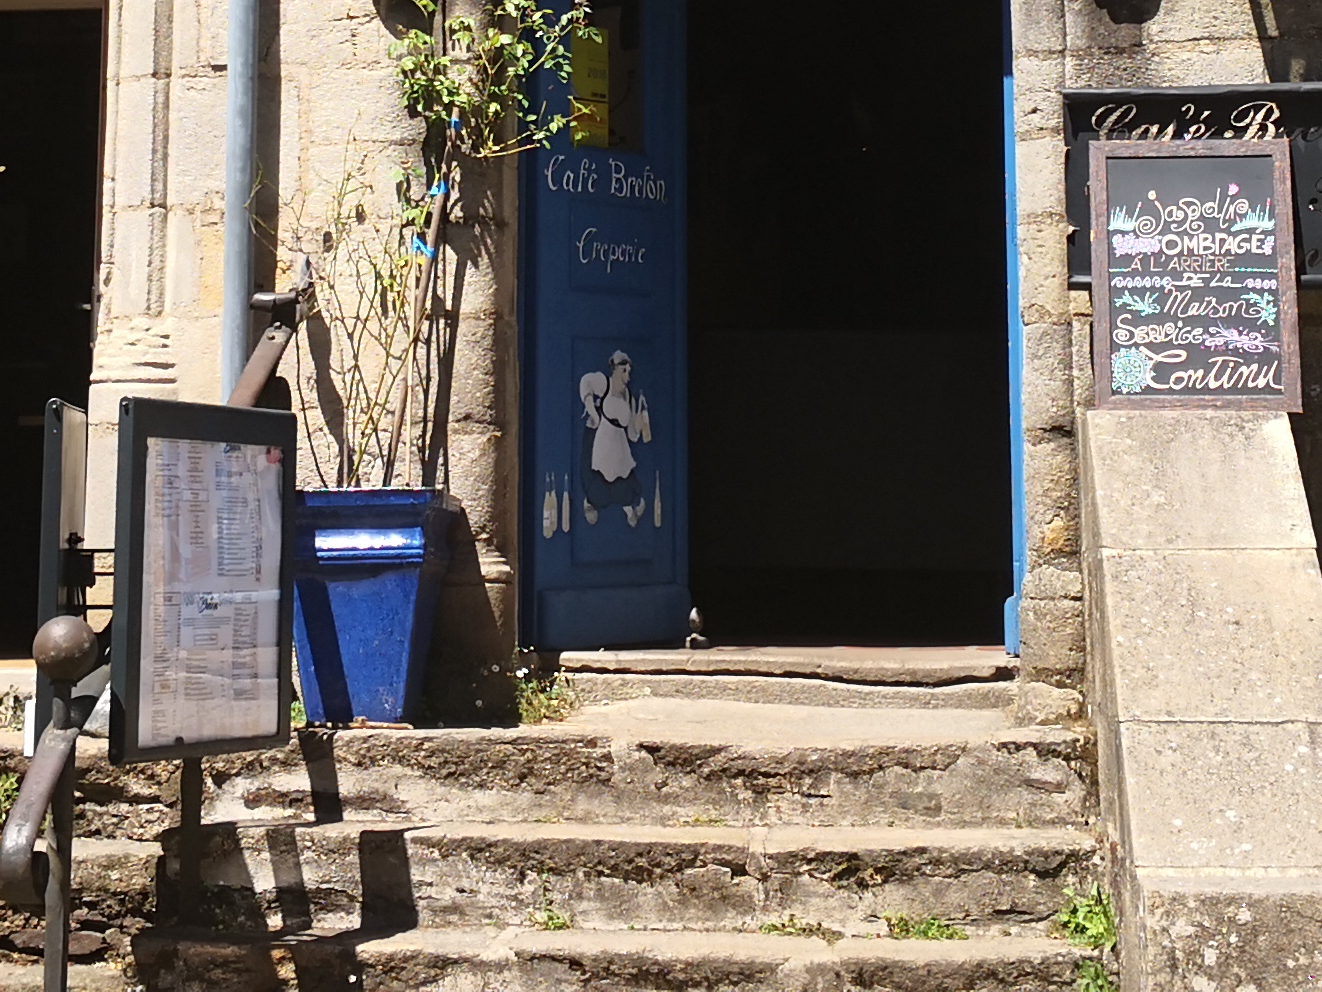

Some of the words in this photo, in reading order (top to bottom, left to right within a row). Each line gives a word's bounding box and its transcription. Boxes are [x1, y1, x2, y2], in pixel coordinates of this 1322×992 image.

[544, 154, 597, 193] Café
[609, 158, 667, 204] Breton
[576, 227, 646, 274] Creperie
[1138, 345, 1284, 389] Continu
